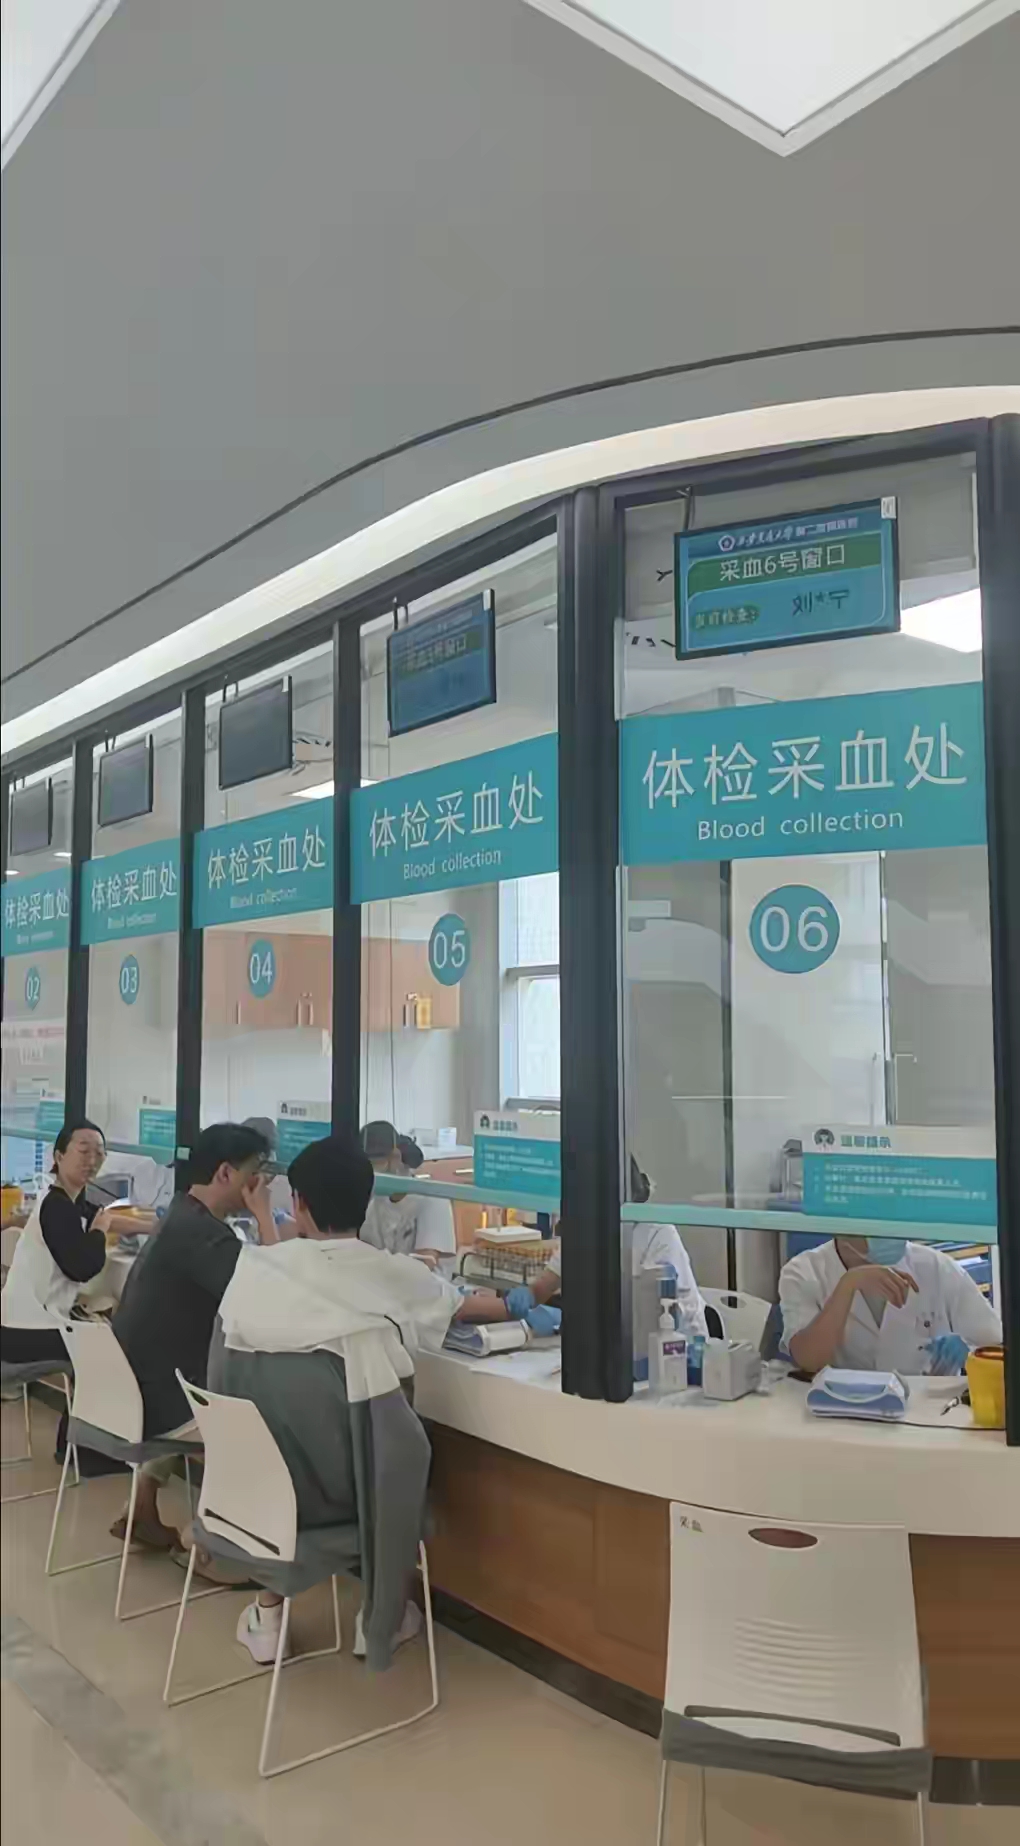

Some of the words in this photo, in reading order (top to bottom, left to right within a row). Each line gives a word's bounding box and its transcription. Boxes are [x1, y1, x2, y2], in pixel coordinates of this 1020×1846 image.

[719, 543, 846, 582] 采血6号窗口
[642, 722, 968, 810] 体检采血处
[369, 770, 544, 860] 体检采血处
[697, 816, 766, 841] Blood
[780, 808, 904, 836] collection
[207, 824, 326, 890] 体检采血处
[403, 856, 436, 880] Blood
[441, 848, 502, 873] collection
[91, 860, 178, 913] 体检采血处
[5, 887, 70, 929] 体检采血处
[433, 929, 466, 970] 05
[759, 905, 830, 953] 06
[26, 976, 40, 1001] 02
[121, 966, 138, 995] 03
[250, 951, 273, 985] 04
